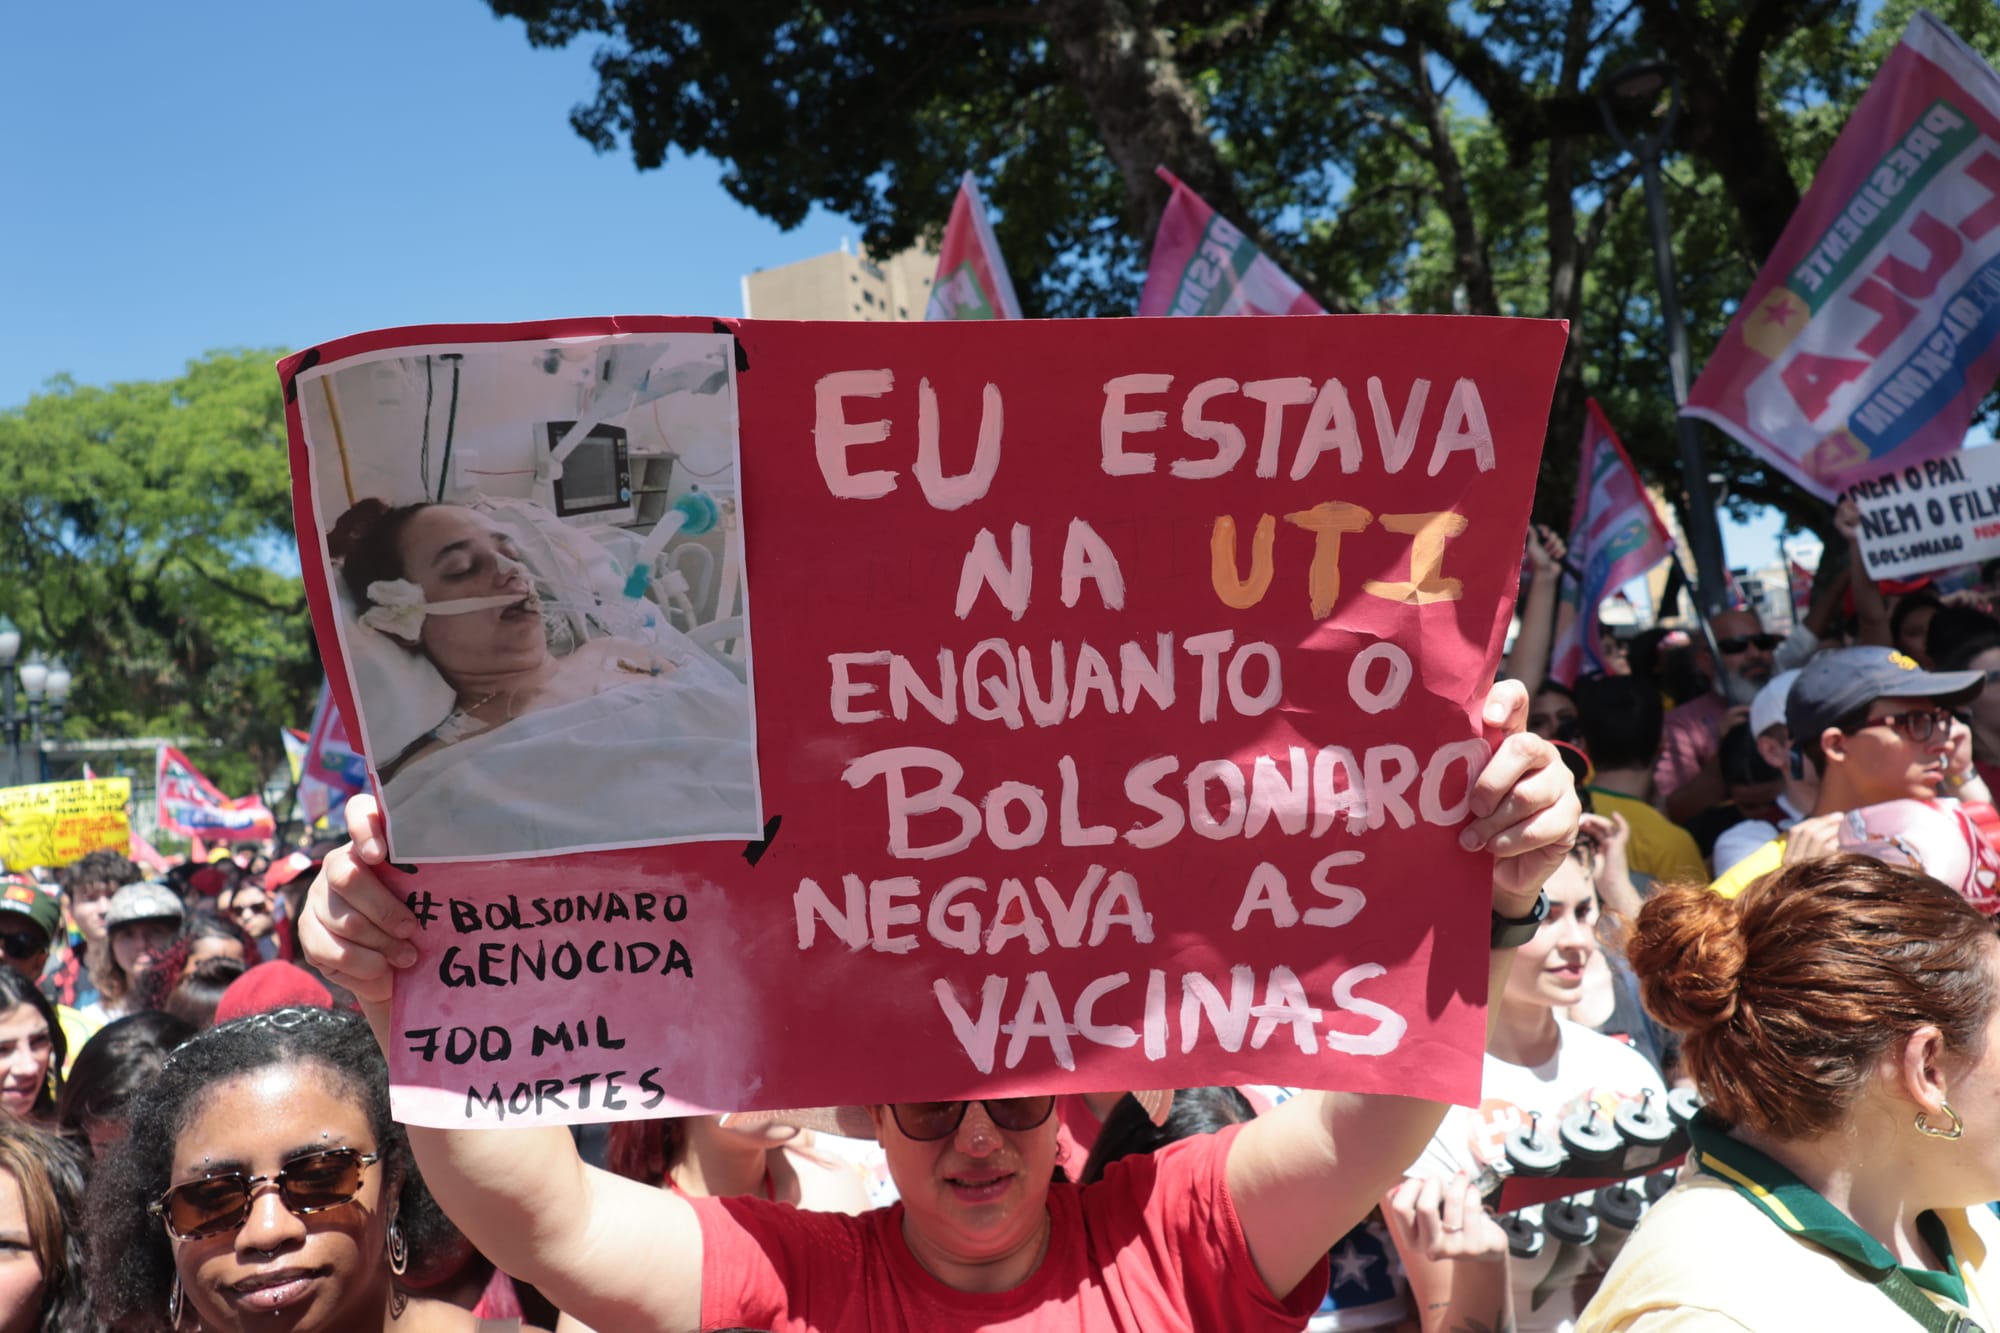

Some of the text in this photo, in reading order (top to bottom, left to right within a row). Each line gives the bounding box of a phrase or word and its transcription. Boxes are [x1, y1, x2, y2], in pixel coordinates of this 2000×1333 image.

[811, 368, 1496, 510] EU ESTAVA
[1849, 457, 1966, 502] NEM O PAI
[1859, 502, 1922, 540] NEM
[1926, 497, 1945, 527] O
[955, 500, 1469, 620] NA UTI
[1867, 534, 1964, 568] BOLSONARO
[828, 629, 1413, 730] ENQUANTO O
[841, 737, 1493, 860] BOLSONARO
[404, 890, 689, 934] #BOLSONARO
[792, 850, 1367, 955] NEGAVA AS
[438, 938, 694, 988] GENOCIDA
[404, 1015, 627, 1065] 700 MIL
[933, 962, 1407, 1074] VACINAS
[464, 1066, 666, 1122] MORTES
